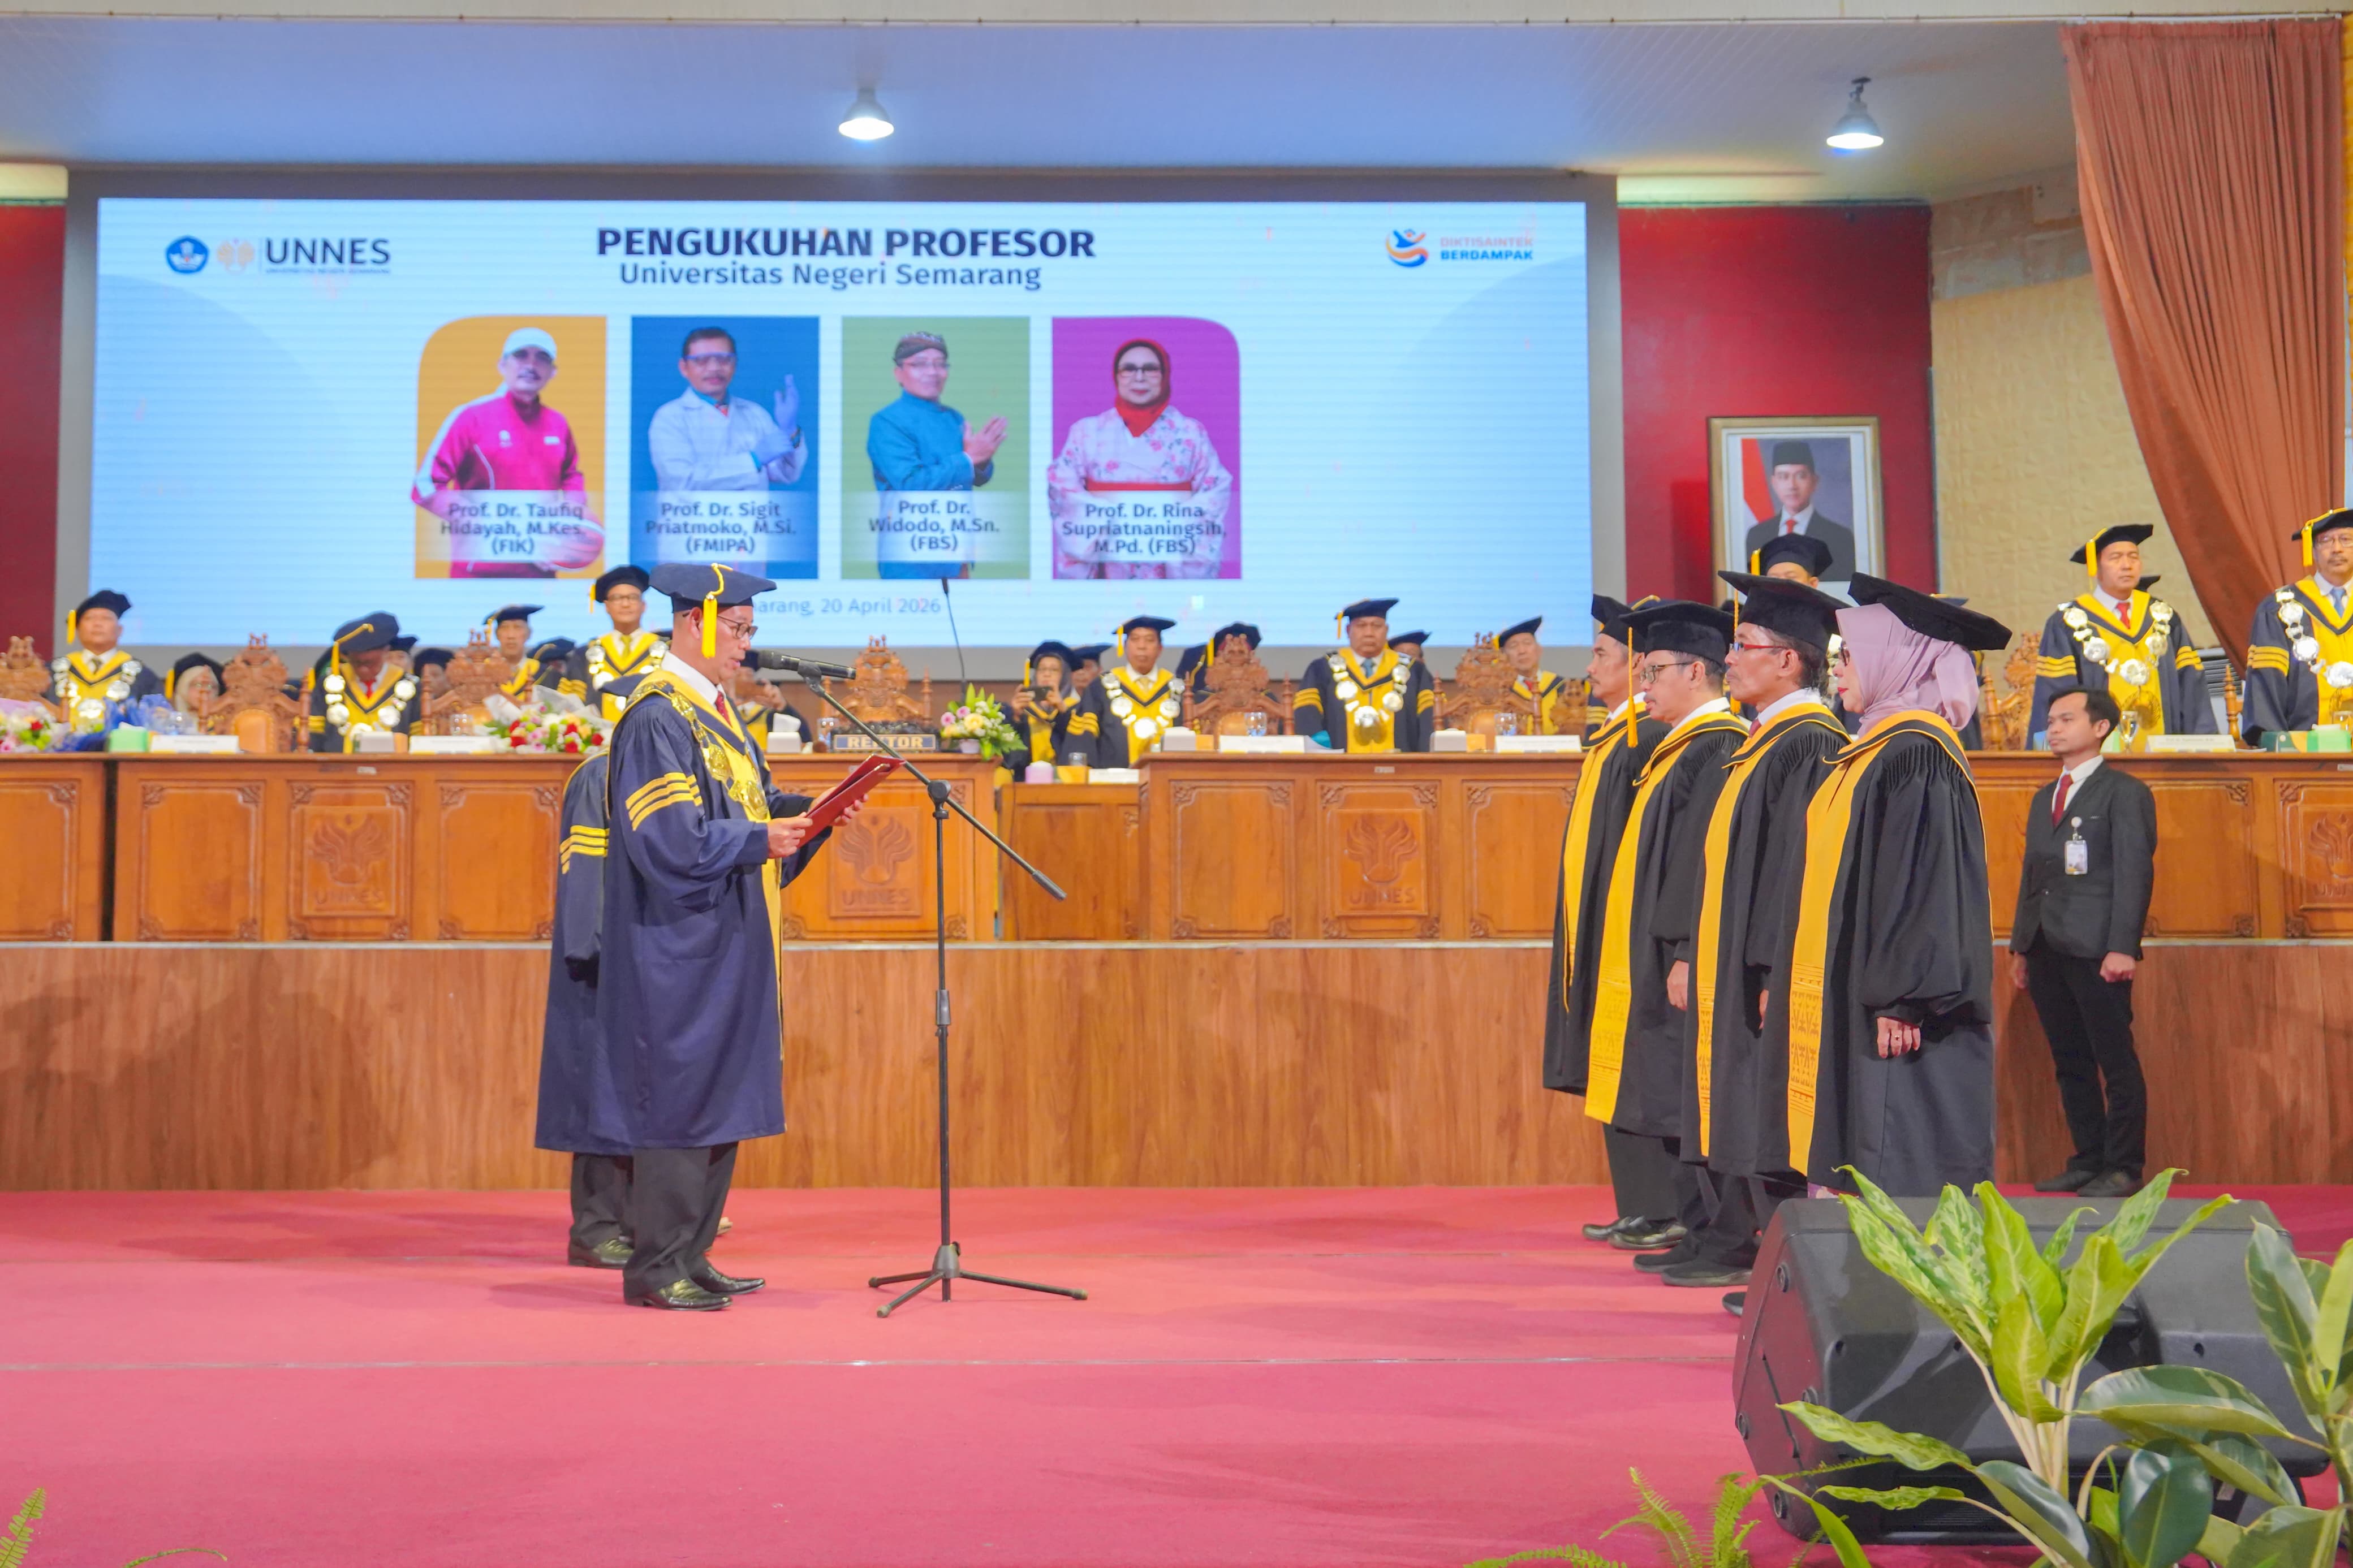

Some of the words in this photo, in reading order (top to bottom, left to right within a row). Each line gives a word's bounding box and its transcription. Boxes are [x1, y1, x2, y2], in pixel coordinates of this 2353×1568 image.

[597, 228, 872, 256] PENGUKUHAN
[886, 228, 1096, 256] PROFESOR
[1441, 237, 1533, 247] DIKTISAINTEK
[266, 238, 390, 264] UNNES
[1441, 250, 1533, 260] BERDAMPAK
[620, 261, 783, 286] Universitas
[794, 261, 886, 290] Negeri
[897, 264, 1042, 290] Semarang
[449, 502, 490, 517] Prof.
[497, 503, 521, 516] Dr.
[526, 502, 583, 520] Taufiq
[661, 502, 703, 517] Prof.
[710, 503, 734, 517] Dr.
[739, 502, 781, 520] Sigit
[899, 500, 940, 515] Prof.
[947, 502, 971, 515] Dr.
[1086, 504, 1128, 517] Prof.
[1134, 504, 1158, 517] Dr.
[1163, 503, 1204, 517] Rina
[441, 521, 522, 537] Hidayah,
[527, 522, 586, 534] M.Kes.
[645, 520, 748, 538] Priatmoko,
[753, 520, 797, 535] M.Si.
[869, 518, 946, 535] Widodo,
[951, 520, 1000, 532] M.Sn.
[1063, 520, 1227, 539] Supriatnaningsih,
[492, 538, 535, 555] (FIK)
[686, 538, 756, 555] (FMIPA)
[910, 536, 958, 552] (FBS)
[1094, 539, 1143, 554] M.Pd.
[1148, 539, 1196, 555] (FBS)
[754, 599, 815, 616] arang,
[820, 598, 843, 612] 20
[848, 598, 891, 616] April
[898, 598, 941, 612] 2026
